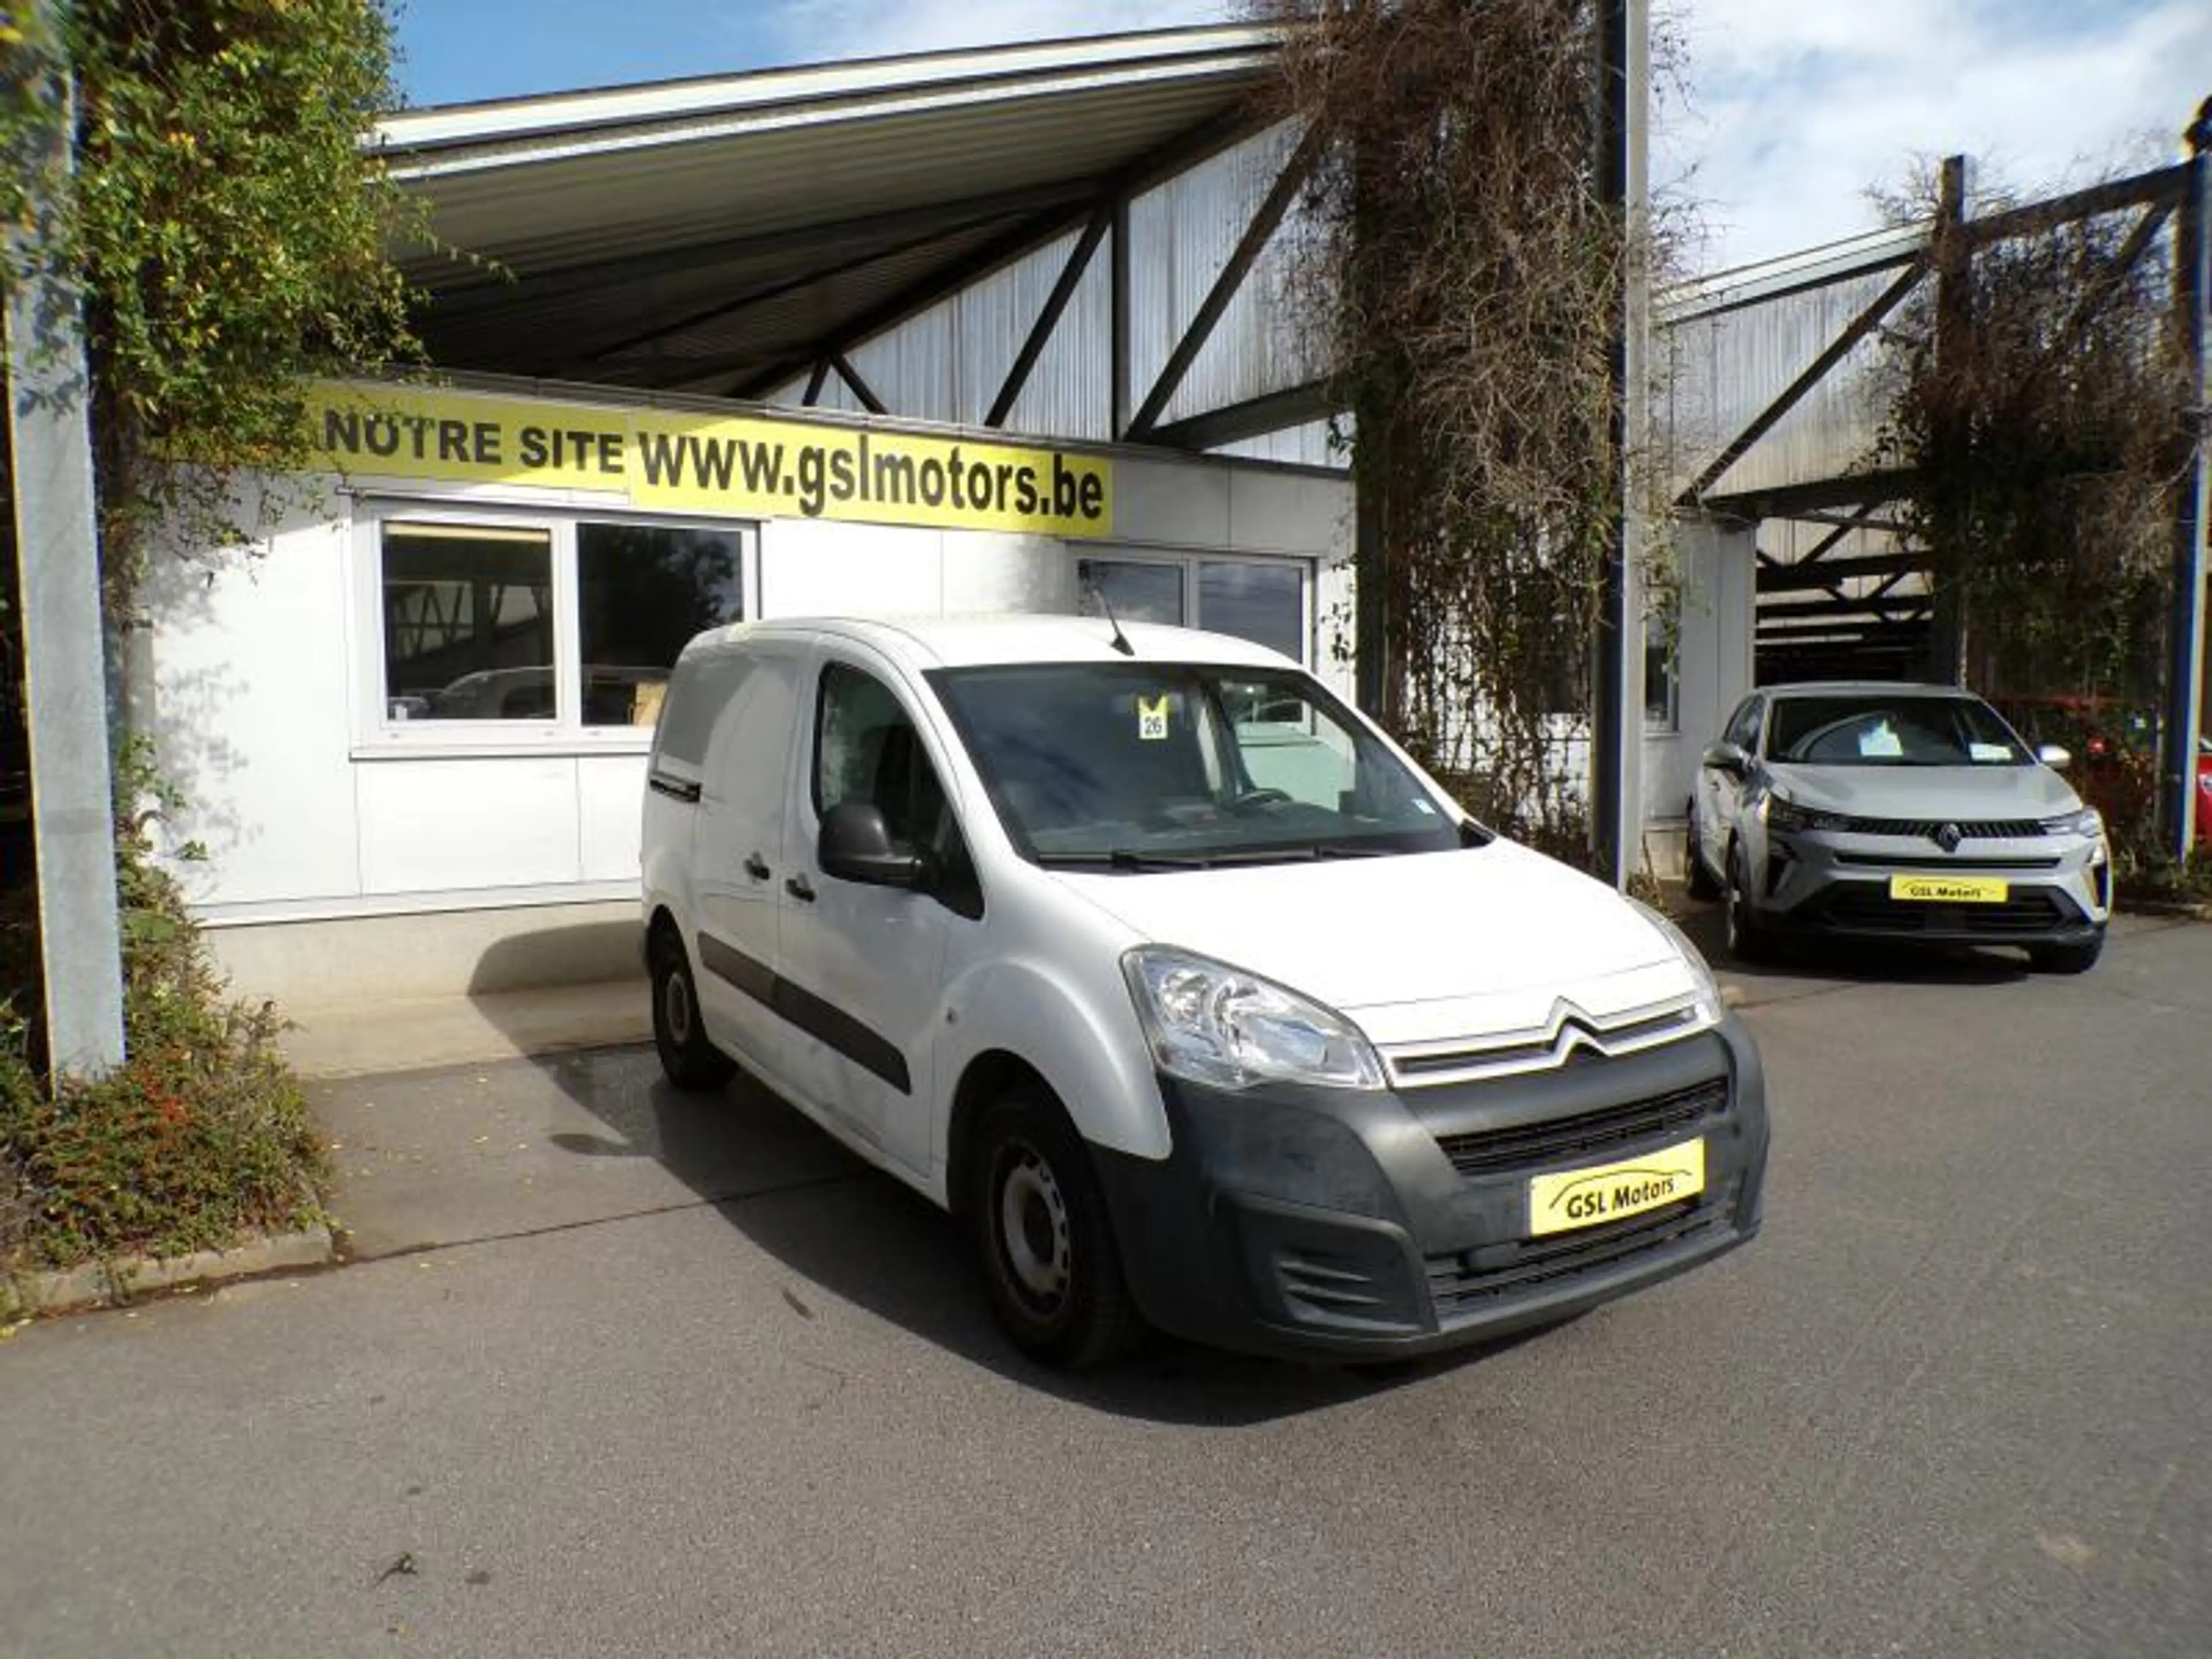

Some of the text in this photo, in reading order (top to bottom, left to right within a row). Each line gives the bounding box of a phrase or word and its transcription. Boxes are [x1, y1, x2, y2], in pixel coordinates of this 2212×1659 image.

[324, 408, 502, 464] NOTRE
[520, 427, 624, 474] SITE
[1145, 716, 1162, 736] 26
[1566, 1177, 1674, 1218] GSL Motors
